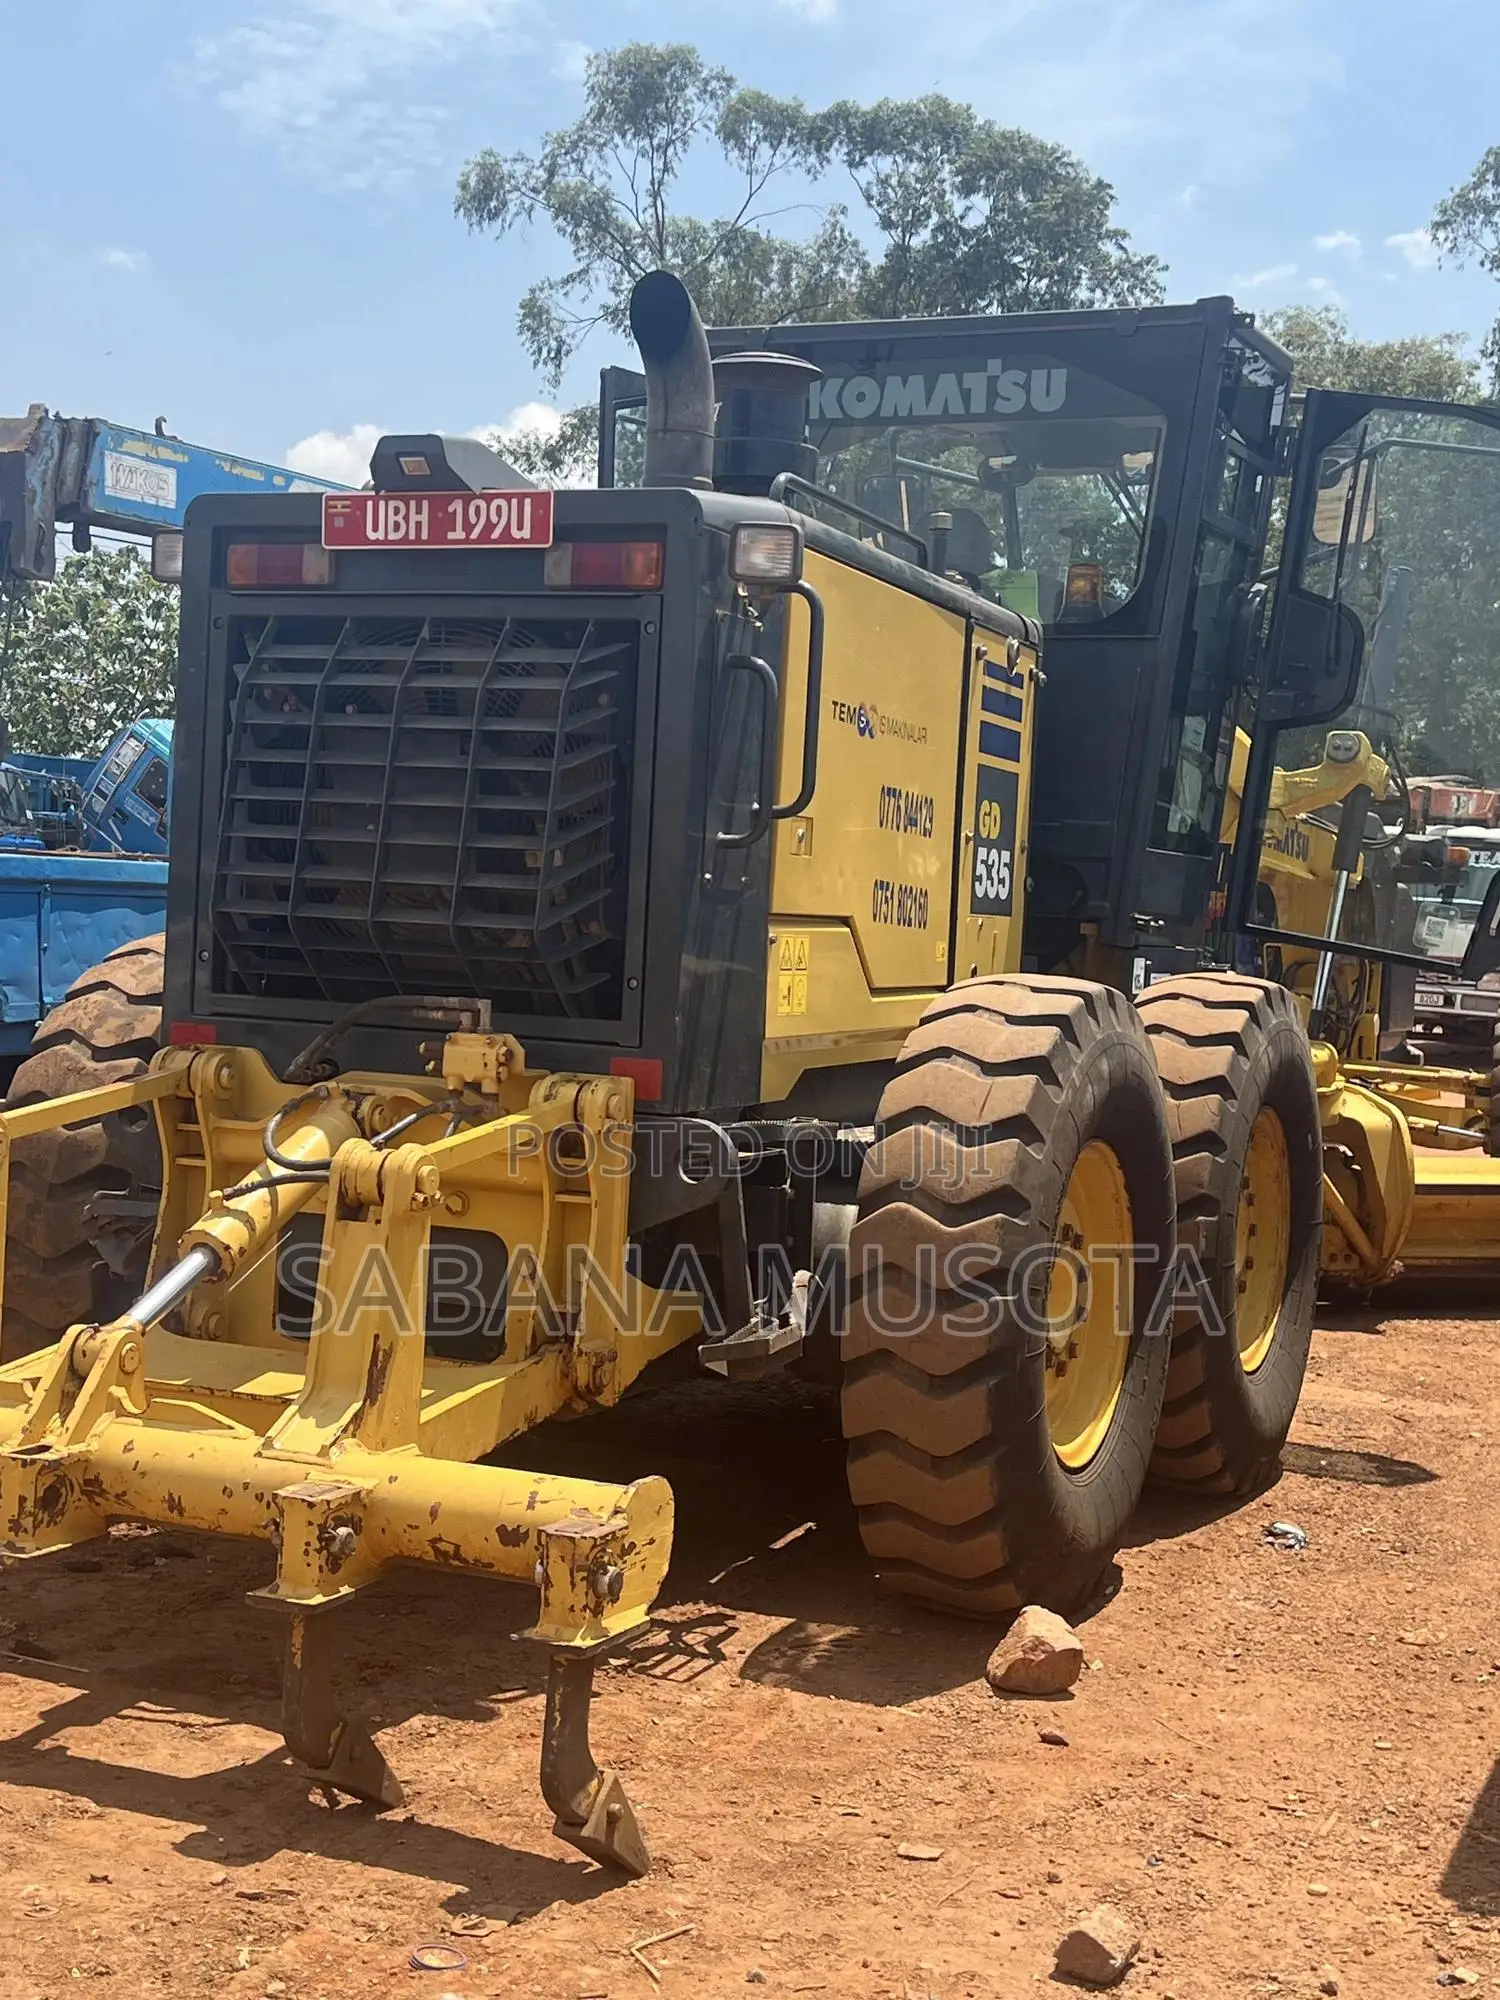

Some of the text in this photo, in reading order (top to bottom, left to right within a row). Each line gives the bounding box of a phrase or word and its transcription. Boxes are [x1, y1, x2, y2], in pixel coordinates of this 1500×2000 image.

[808, 359, 1067, 420] KOMATSU
[366, 498, 532, 540] UBH 199U
[879, 784, 902, 832] 0776
[979, 800, 1001, 839] GD
[975, 847, 1010, 900] 535
[872, 879, 929, 930] 0751 802160
